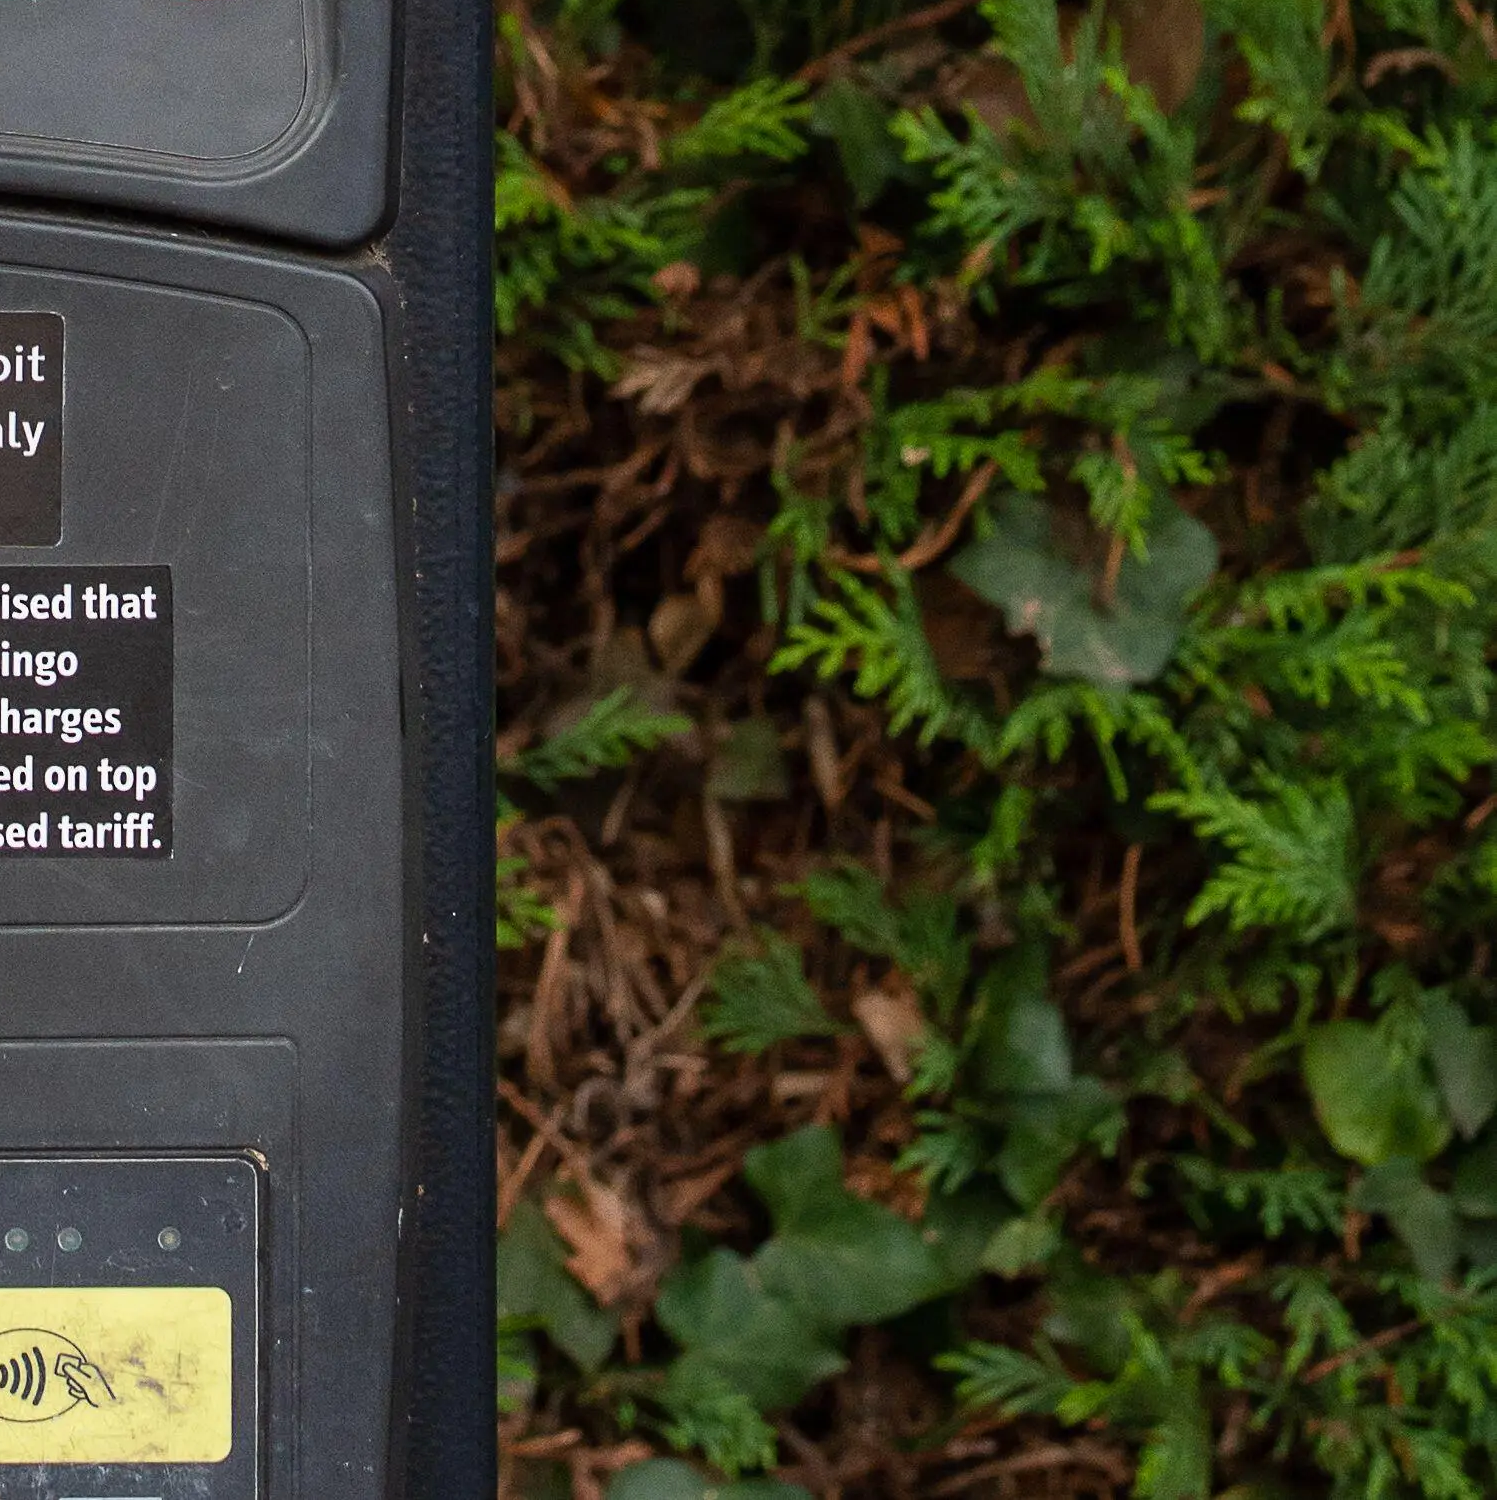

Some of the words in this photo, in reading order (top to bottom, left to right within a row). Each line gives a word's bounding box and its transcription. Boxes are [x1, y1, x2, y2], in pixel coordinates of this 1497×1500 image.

[81, 583, 157, 620] that
[44, 765, 88, 792] on
[96, 757, 157, 802] top
[57, 811, 162, 849] tariff.
